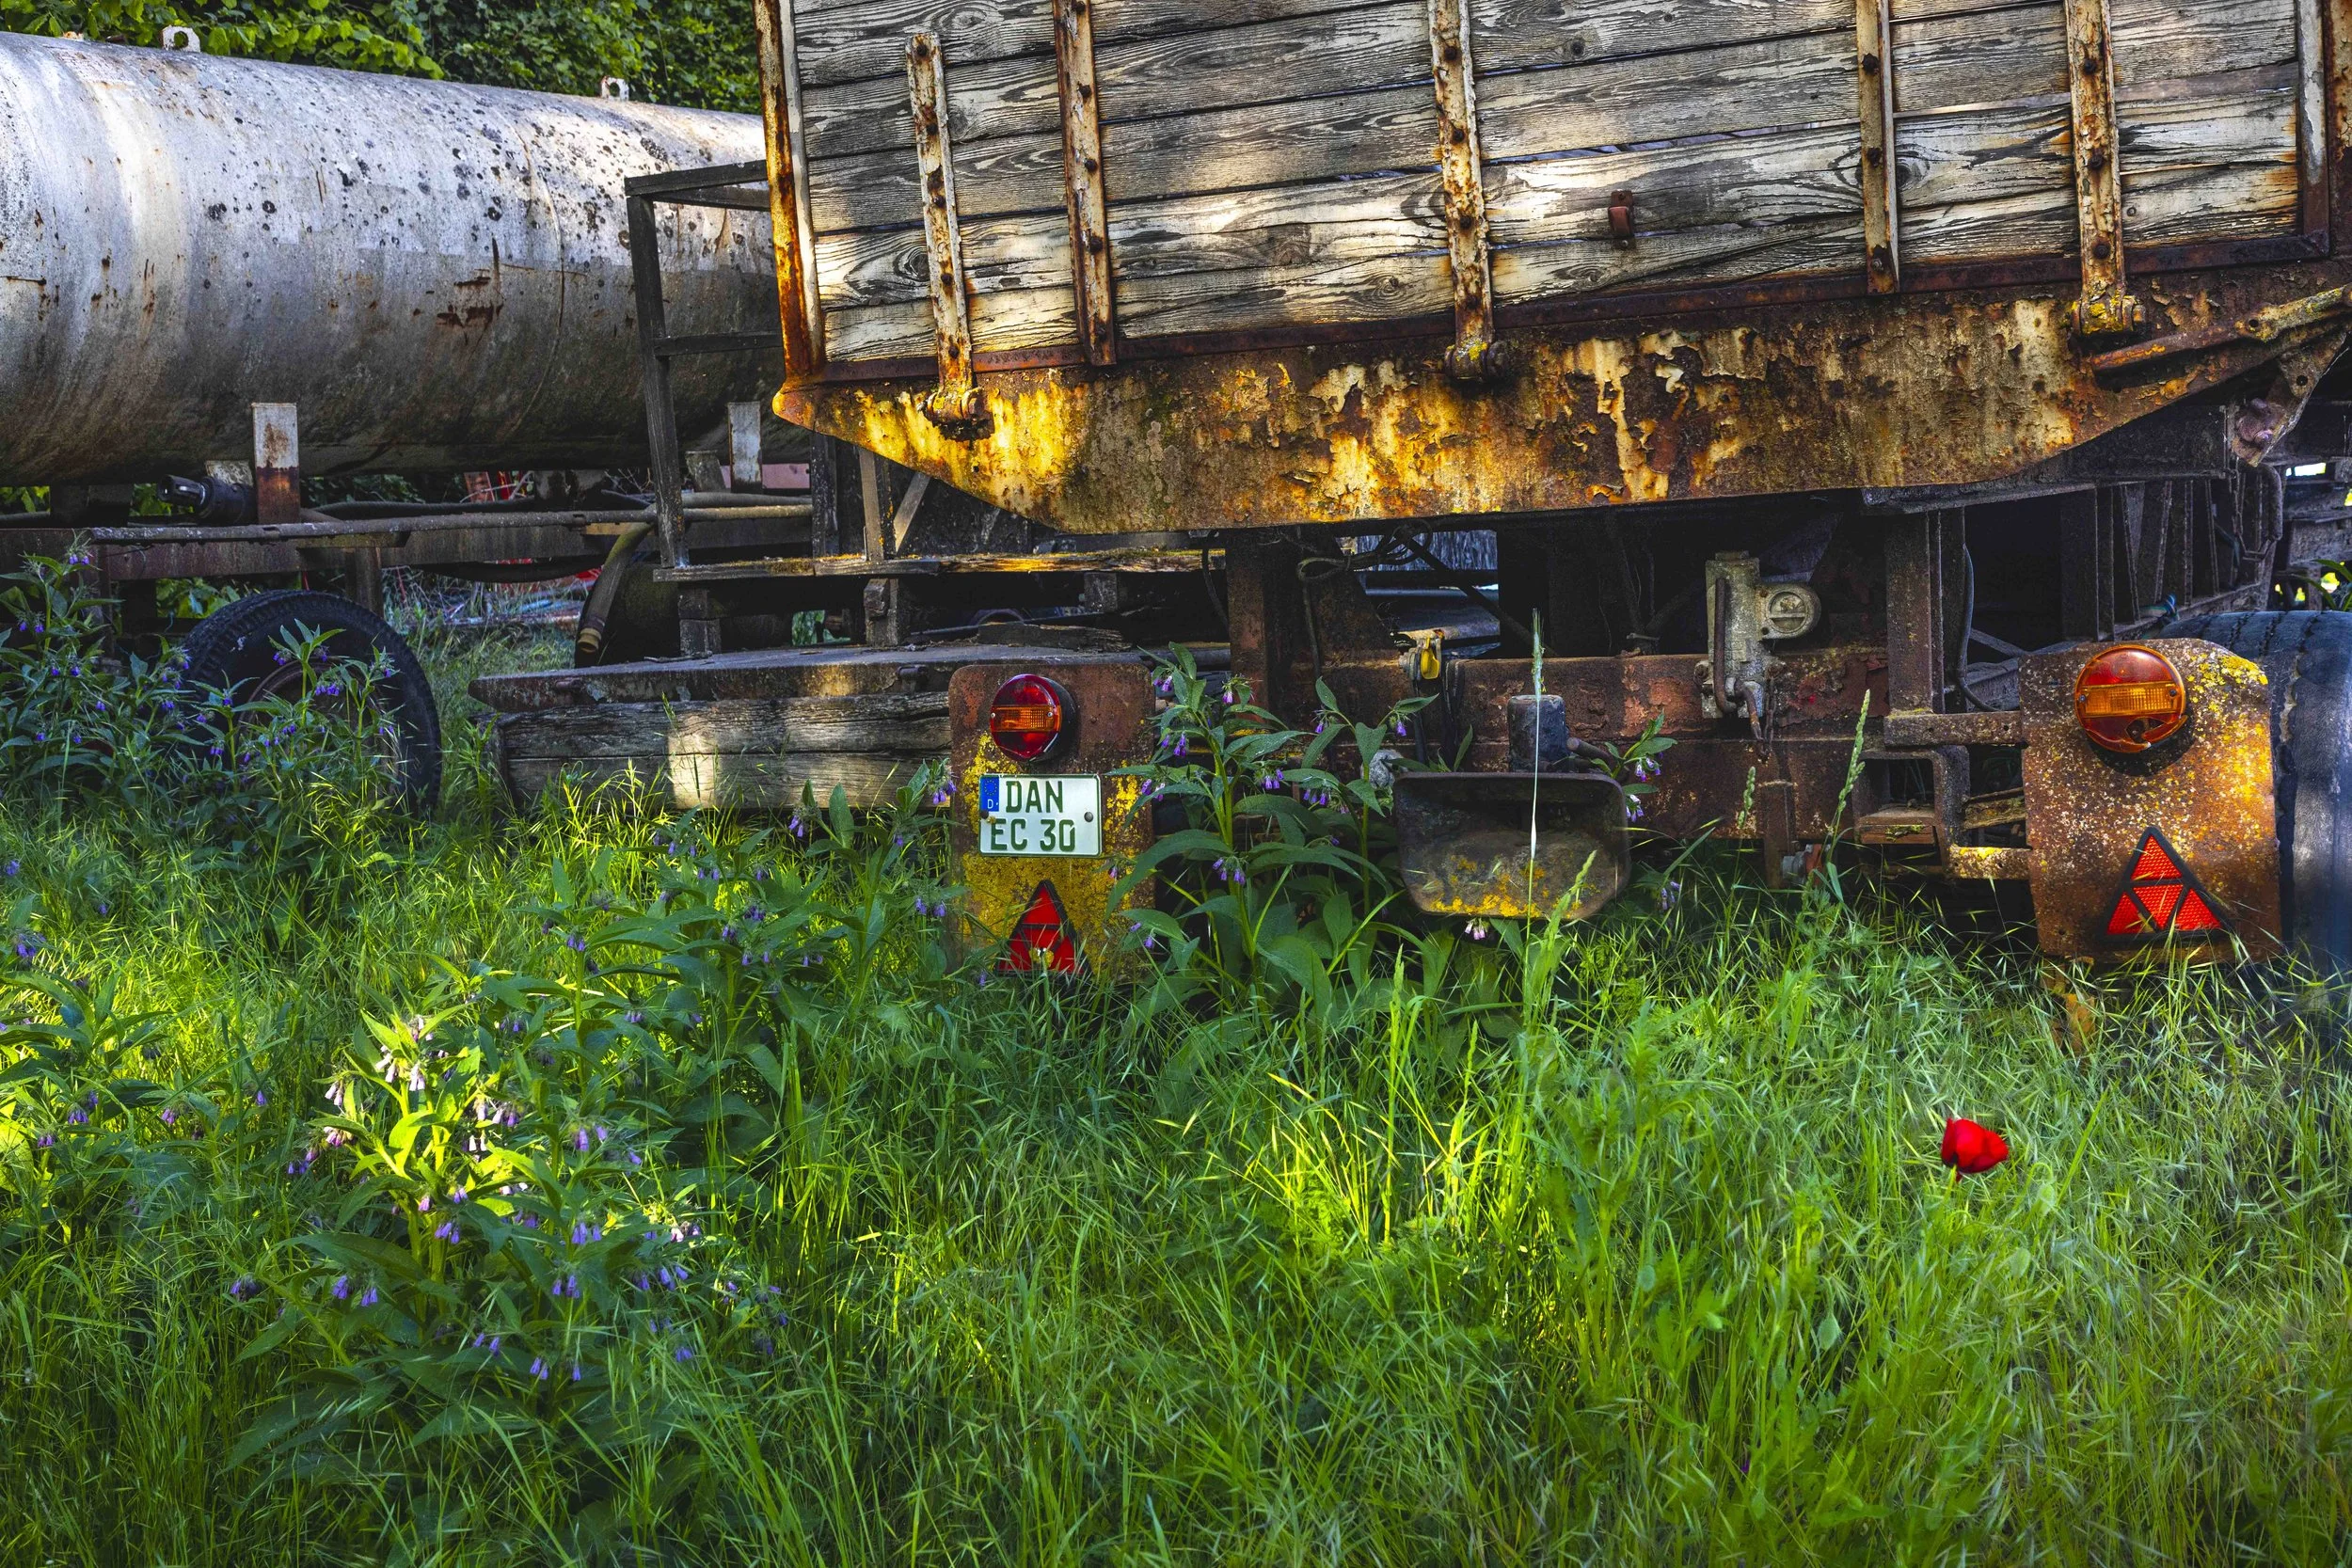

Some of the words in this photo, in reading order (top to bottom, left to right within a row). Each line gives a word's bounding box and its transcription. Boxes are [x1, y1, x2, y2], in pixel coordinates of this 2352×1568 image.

[987, 799, 994, 810] D
[1006, 781, 1064, 813] DAN
[990, 818, 1028, 851] EC
[1040, 819, 1076, 852] 30
